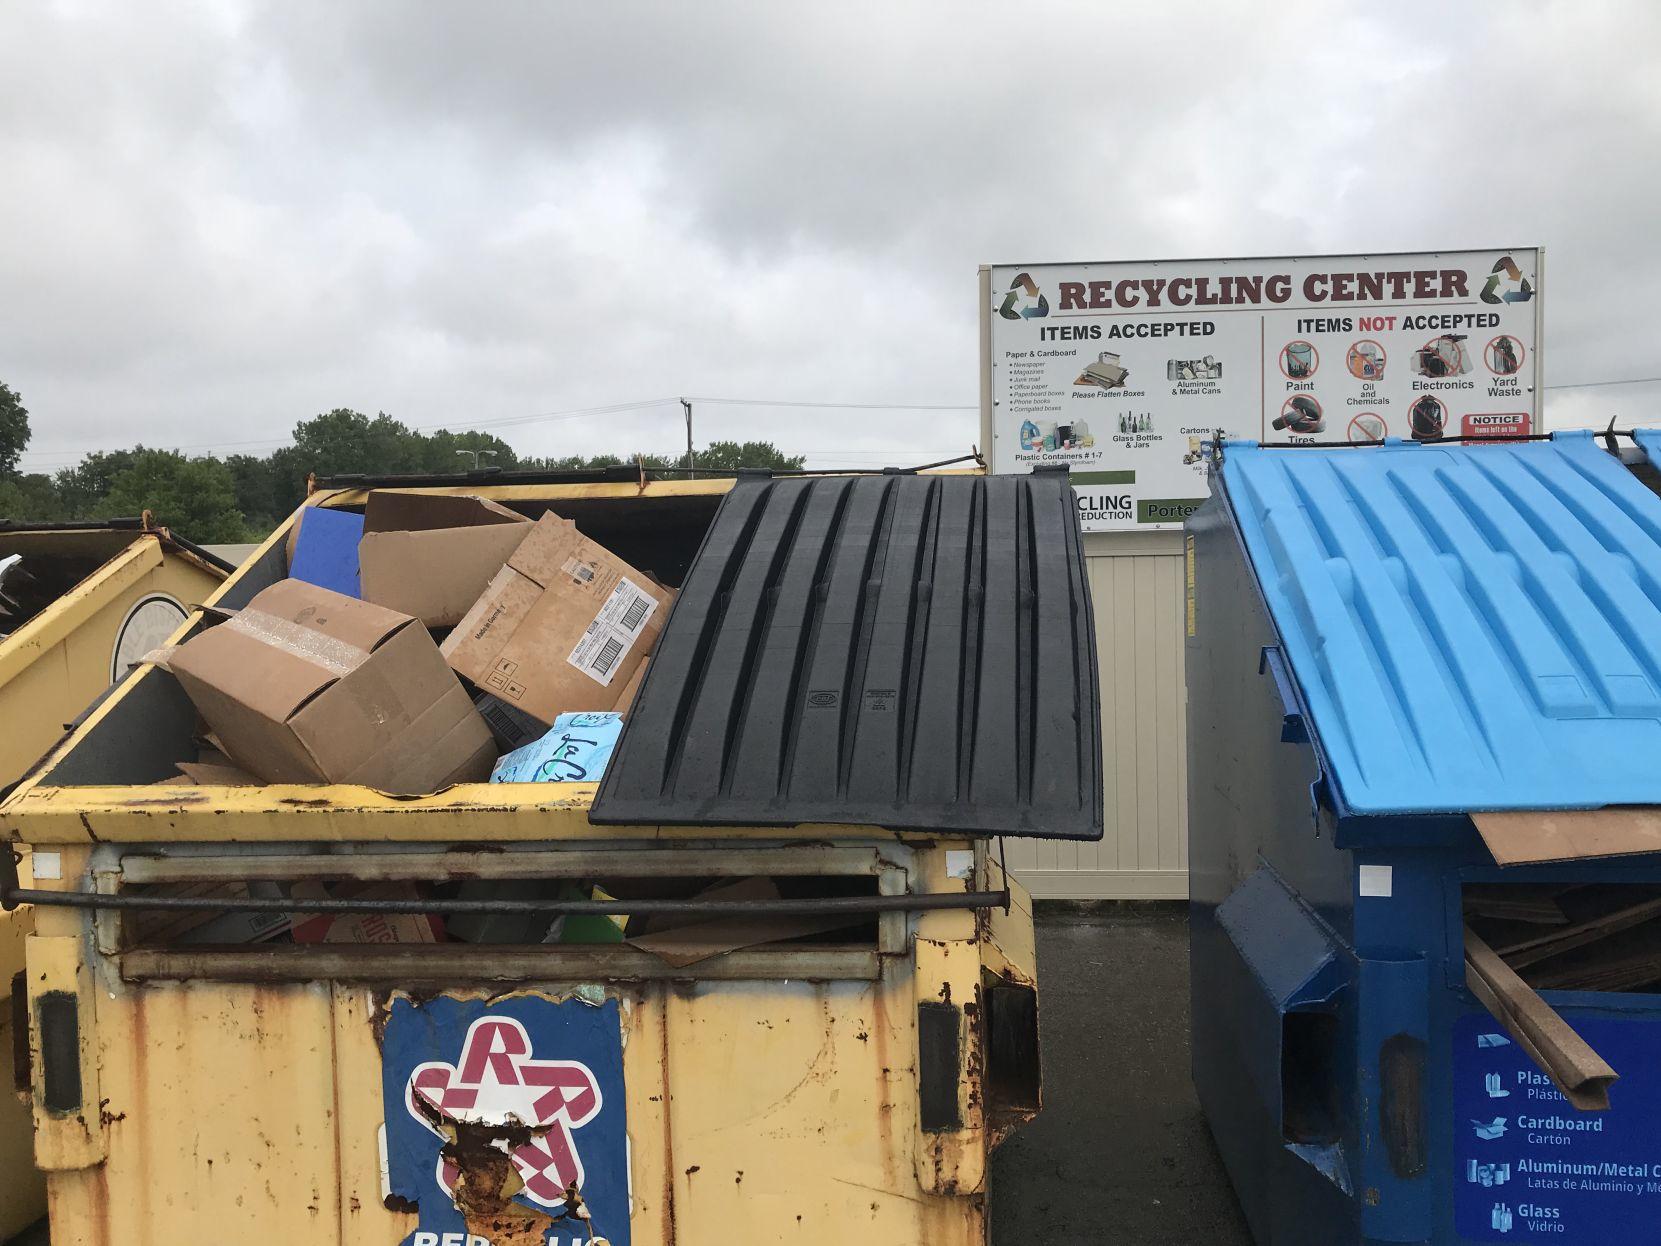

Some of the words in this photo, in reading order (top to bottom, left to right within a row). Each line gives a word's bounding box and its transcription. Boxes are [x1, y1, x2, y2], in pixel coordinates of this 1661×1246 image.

[1059, 275, 1292, 310] RECYCLING
[1303, 270, 1469, 302] CENTER
[1297, 317, 1353, 333] ITEMS
[1359, 316, 1397, 332] NOT
[1402, 312, 1500, 330] ACCEPTED
[1040, 325, 1102, 341] ITEMS
[1108, 321, 1215, 339] ACCEPTED
[1005, 351, 1028, 359] Paper
[1029, 350, 1035, 358] &
[1037, 349, 1077, 357] Cardboard
[1176, 380, 1216, 388] Aluminum
[1286, 381, 1315, 391] Paint
[1362, 383, 1375, 391] Oil
[1412, 379, 1475, 391] Electronics
[1492, 377, 1518, 387] Yard
[1071, 391, 1096, 399] Please
[1096, 390, 1121, 398] Flatten
[1122, 389, 1145, 398] Boxes
[1171, 388, 1178, 396] &
[1201, 387, 1222, 395] Cans
[1360, 390, 1376, 398] and
[1487, 387, 1522, 397] Waste
[1346, 397, 1390, 406] Chemicals
[1473, 415, 1520, 425] NOTICE
[1180, 427, 1210, 435] Cartons
[1112, 434, 1134, 443] Glass
[1136, 433, 1163, 442] Bottles
[1288, 435, 1316, 444] Tires
[1133, 441, 1150, 449] Jars
[1015, 453, 1041, 462] Plastic
[1042, 452, 1083, 461] Containers
[1084, 451, 1090, 459] #
[1091, 451, 1103, 459] 1-7
[1077, 495, 1132, 511] CLING
[1080, 511, 1133, 521] EDUCTION
[488, 604, 506, 624] Germay
[1517, 1070, 1554, 1086] Plas
[1517, 1115, 1603, 1132] Cardboard
[1527, 1133, 1571, 1145] Cartón
[1517, 1159, 1648, 1178] Aluminum/Metal
[1527, 1177, 1560, 1189] Latas
[1562, 1178, 1577, 1191] de
[1580, 1179, 1634, 1193] Aluminio
[1636, 1183, 1644, 1196] y
[1518, 1203, 1560, 1219] Glass
[1527, 1220, 1565, 1233] Vidrio
